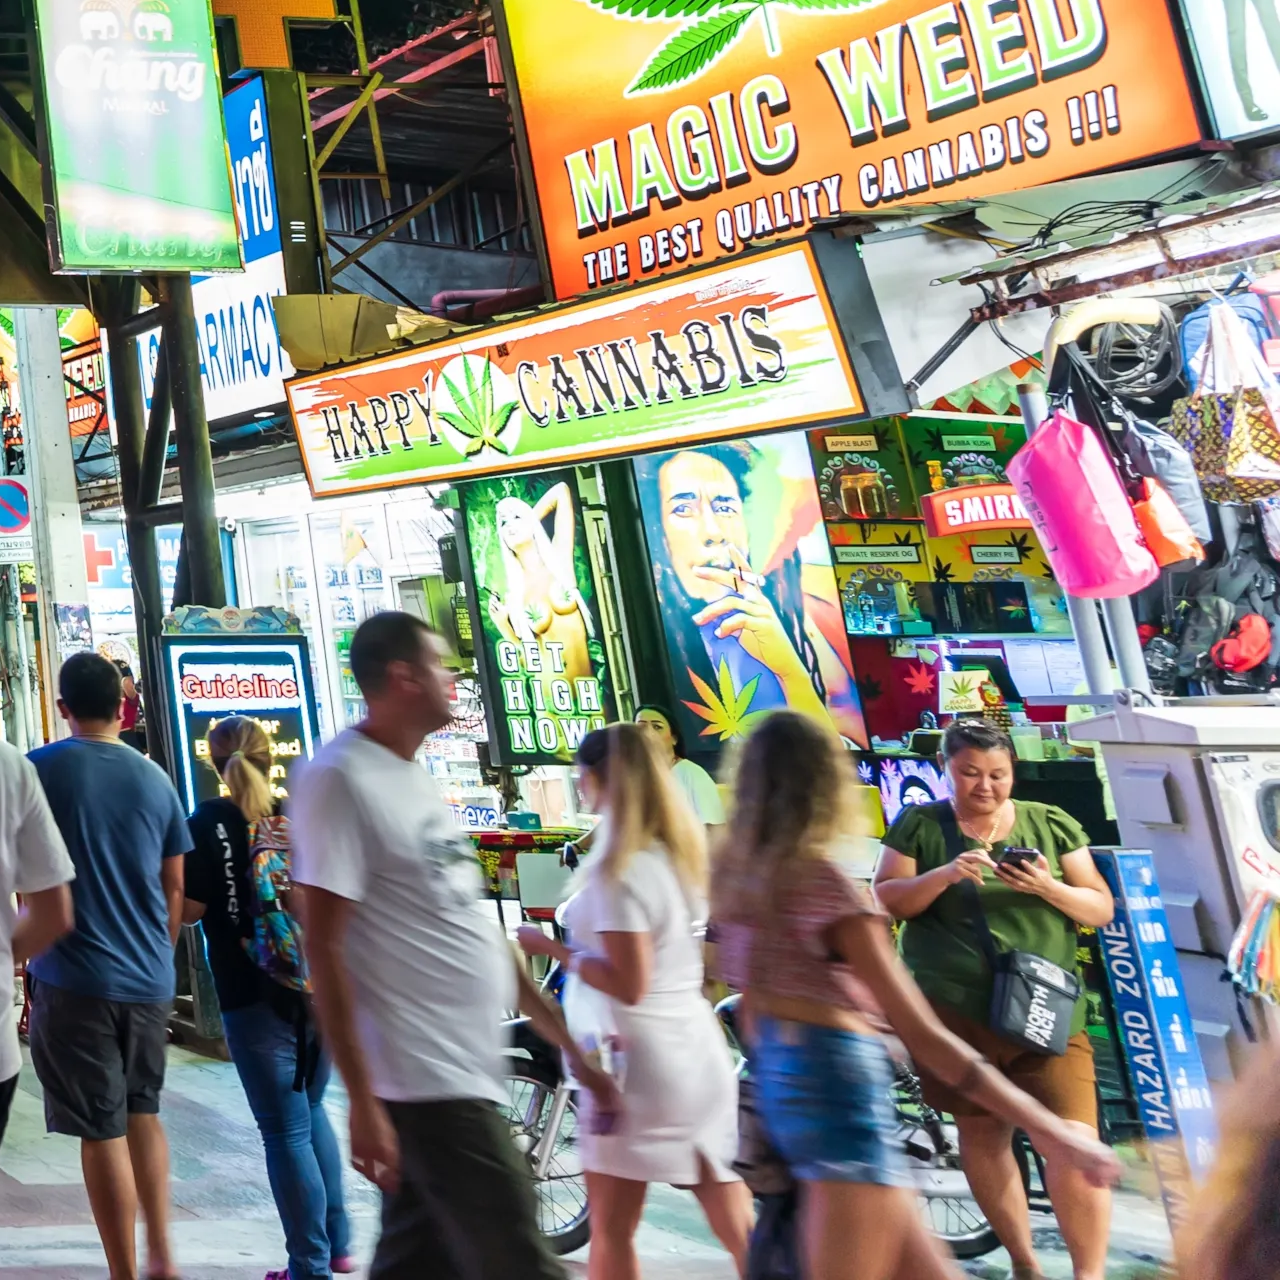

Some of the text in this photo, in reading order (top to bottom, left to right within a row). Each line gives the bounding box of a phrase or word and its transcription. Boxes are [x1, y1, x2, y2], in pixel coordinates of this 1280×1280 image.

[55, 44, 206, 102] Chang
[564, 73, 799, 237] MAGIC
[583, 244, 628, 287] THE
[638, 218, 704, 275] BEST
[717, 173, 843, 250] QUALITY
[858, 109, 1049, 207] CANNABIS
[320, 304, 789, 463] HAPPY CANNABIS
[181, 673, 298, 698] Guideline
[499, 642, 563, 673] GET
[504, 679, 600, 711] HIGH
[1102, 921, 1142, 999] ZONE
[1122, 1010, 1174, 1132] HAZARD
